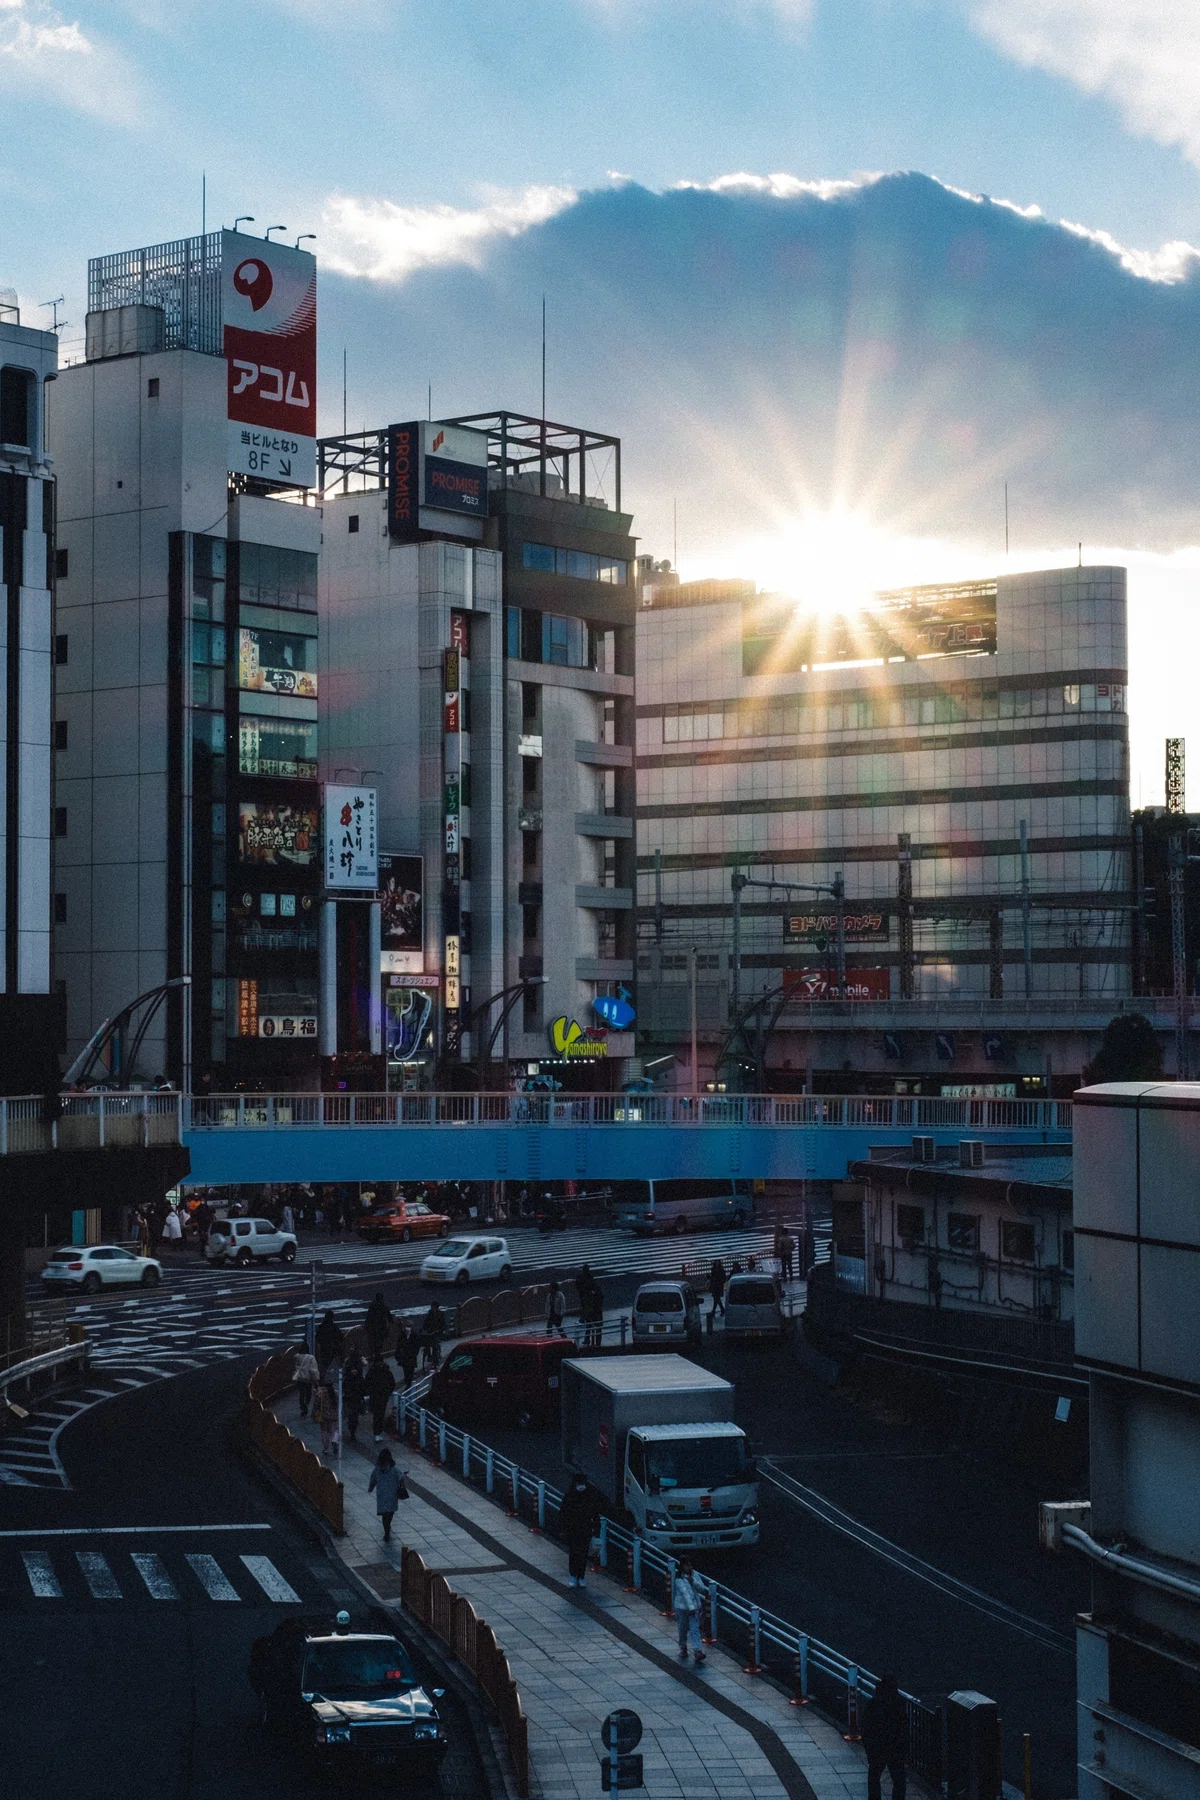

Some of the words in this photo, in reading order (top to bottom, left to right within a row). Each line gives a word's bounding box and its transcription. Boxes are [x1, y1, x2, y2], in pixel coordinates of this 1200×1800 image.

[233, 359, 310, 408] アコム
[241, 430, 298, 454] 当ビルとなり
[248, 451, 270, 471] 8F
[395, 431, 410, 519] PROMISE
[432, 471, 480, 495] PROMISE
[462, 494, 479, 505] プロミス
[250, 631, 259, 640] 7F
[353, 796, 364, 852] やきとり
[395, 976, 435, 985] スポーツジュエン
[280, 1018, 316, 1036] 鳥福
[552, 1015, 608, 1061] Yamashiroya
